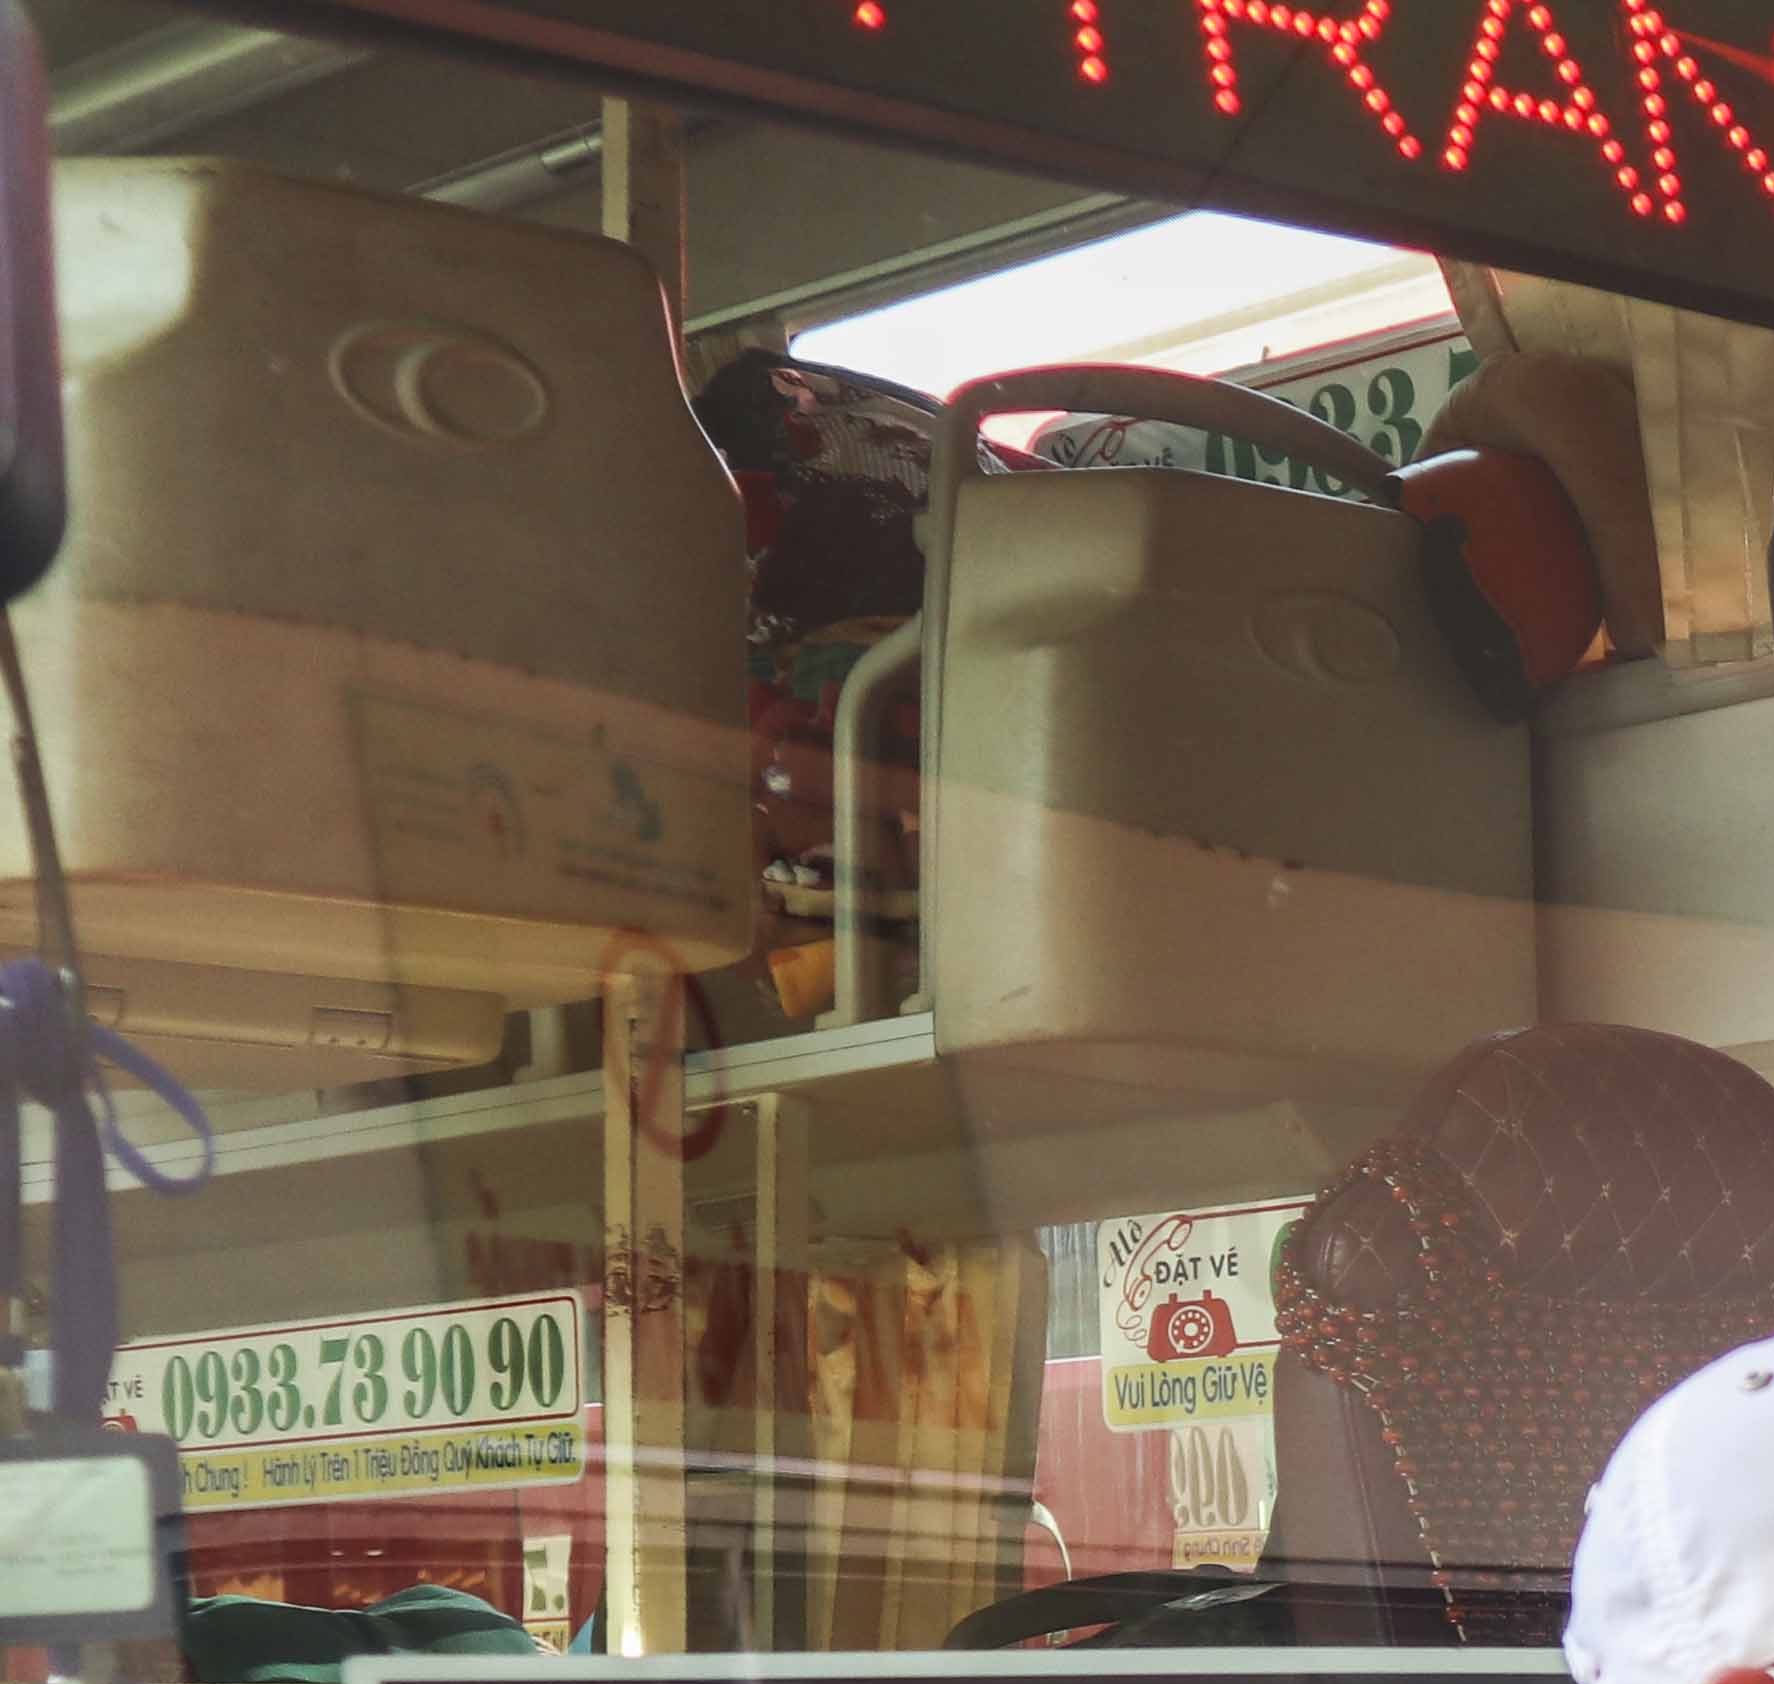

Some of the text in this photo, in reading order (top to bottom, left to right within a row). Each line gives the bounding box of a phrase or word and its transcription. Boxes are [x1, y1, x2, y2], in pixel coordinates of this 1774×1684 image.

[1154, 1247, 1239, 1286] ĐẶT VÉ
[161, 1313, 565, 1442] 0933.73 90 90
[1114, 1362, 1269, 1414] Vui Lòng Giữ Vệ
